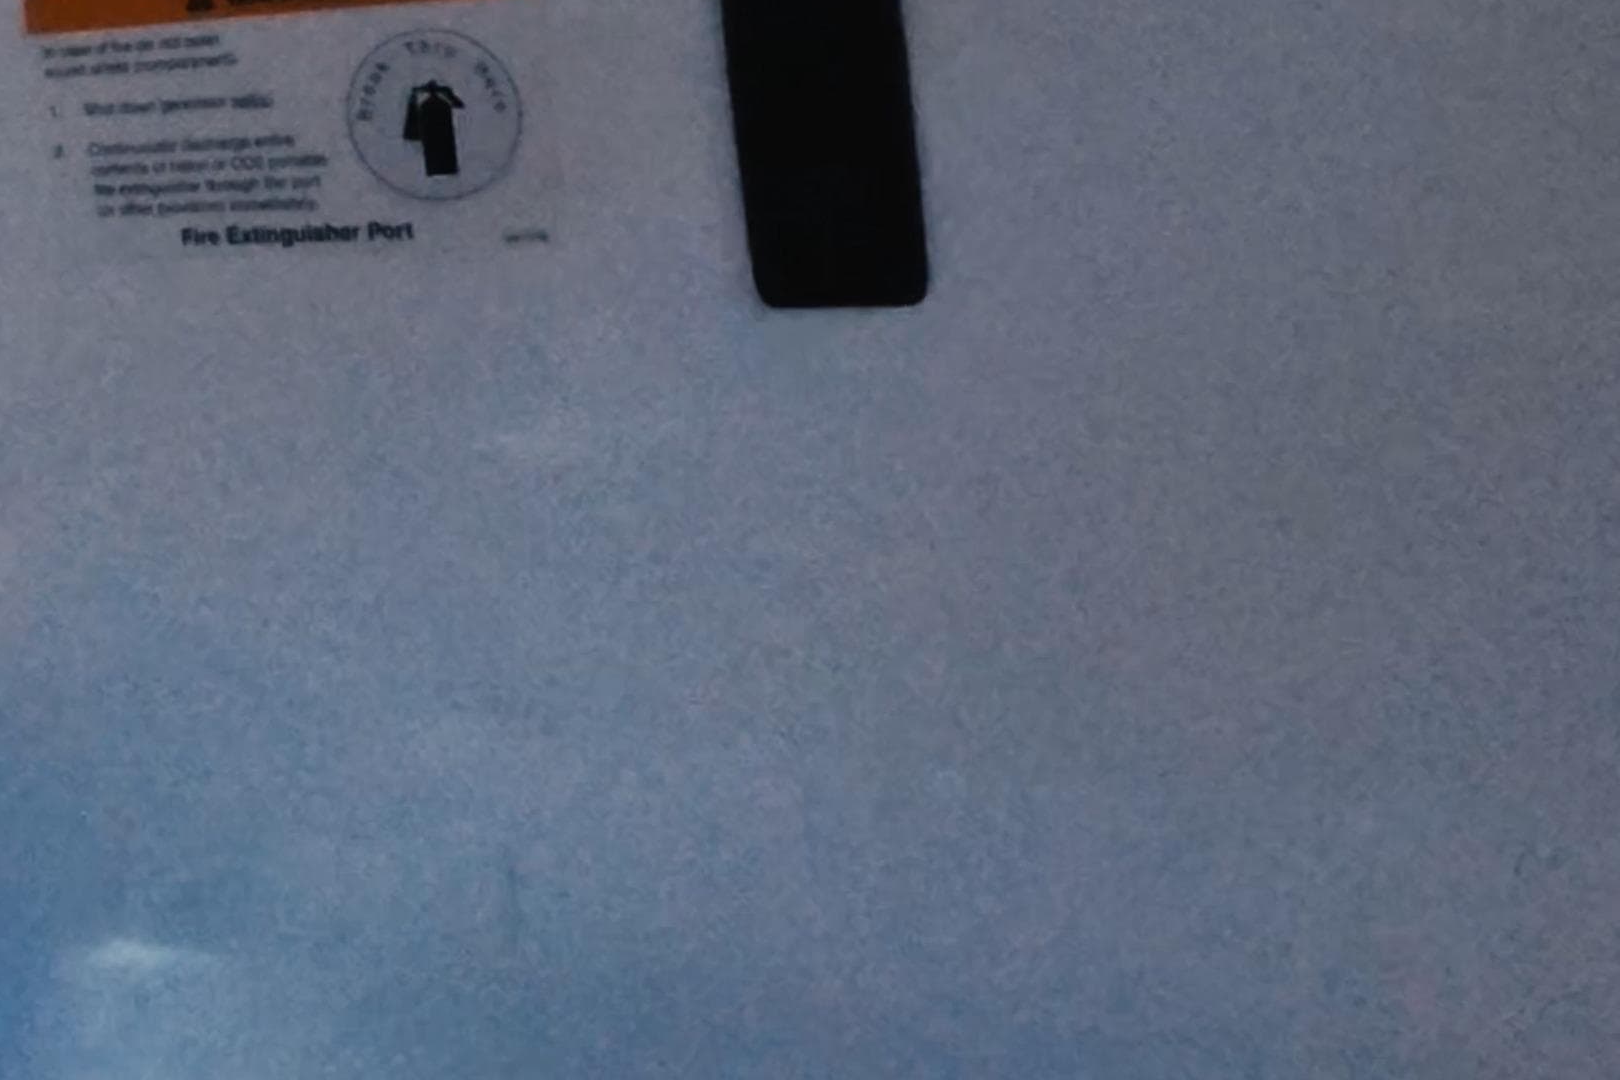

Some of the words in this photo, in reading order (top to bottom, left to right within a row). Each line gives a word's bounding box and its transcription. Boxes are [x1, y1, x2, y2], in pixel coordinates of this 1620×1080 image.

[182, 227, 221, 246] Fire
[226, 223, 360, 248] Extinguisher
[367, 220, 415, 241] Port
